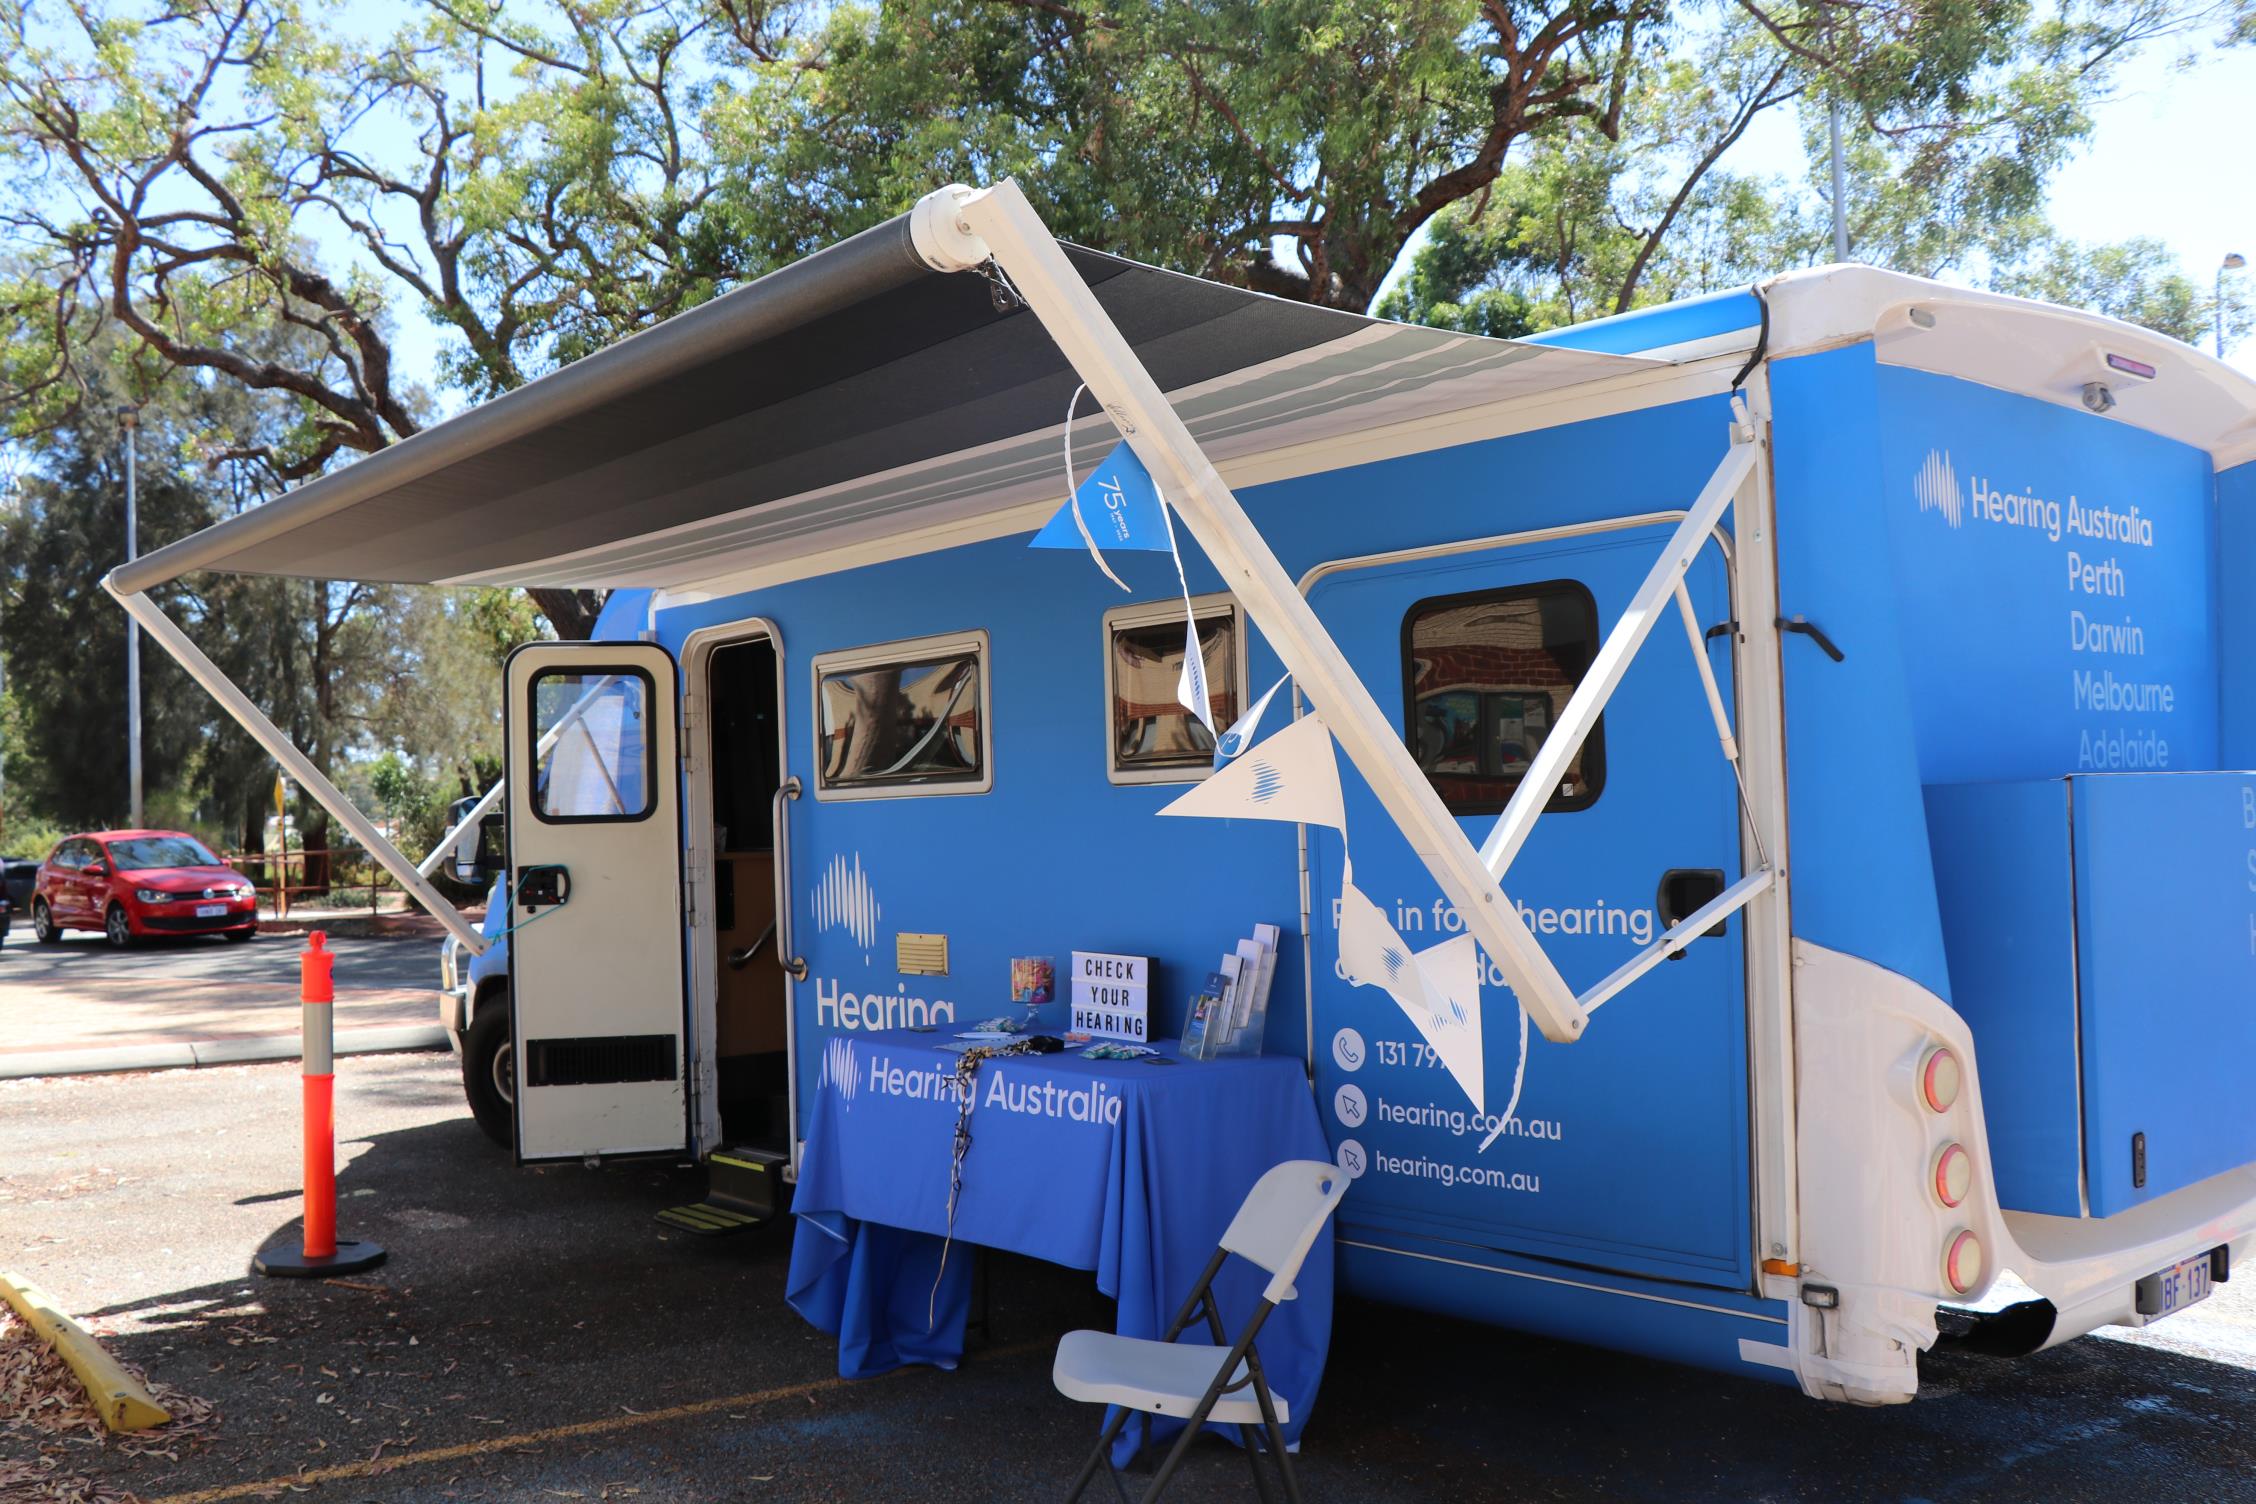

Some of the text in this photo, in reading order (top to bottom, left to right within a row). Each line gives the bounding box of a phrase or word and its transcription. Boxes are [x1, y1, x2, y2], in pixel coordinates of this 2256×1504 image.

[1098, 474, 1127, 510] 75
[1113, 509, 1130, 540] years
[1971, 475, 2153, 547] Hearing Australia
[2067, 551, 2125, 597] Perth
[2070, 610, 2145, 656] Darwin
[2073, 669, 2175, 713] Melbourne
[2077, 728, 2170, 769] Adelaide
[1397, 898, 1423, 931] in
[1517, 899, 1653, 946] hearing
[1086, 959, 1134, 980] CHECK
[1091, 986, 1129, 1007] YOUR
[1076, 1011, 1143, 1036] HEARING
[1375, 1040, 1446, 1070] 131 79
[869, 1056, 1122, 1126] Hearing Australia
[1378, 1097, 1562, 1141] hearing.com.au
[1376, 1150, 1540, 1193] hearing.com.au
